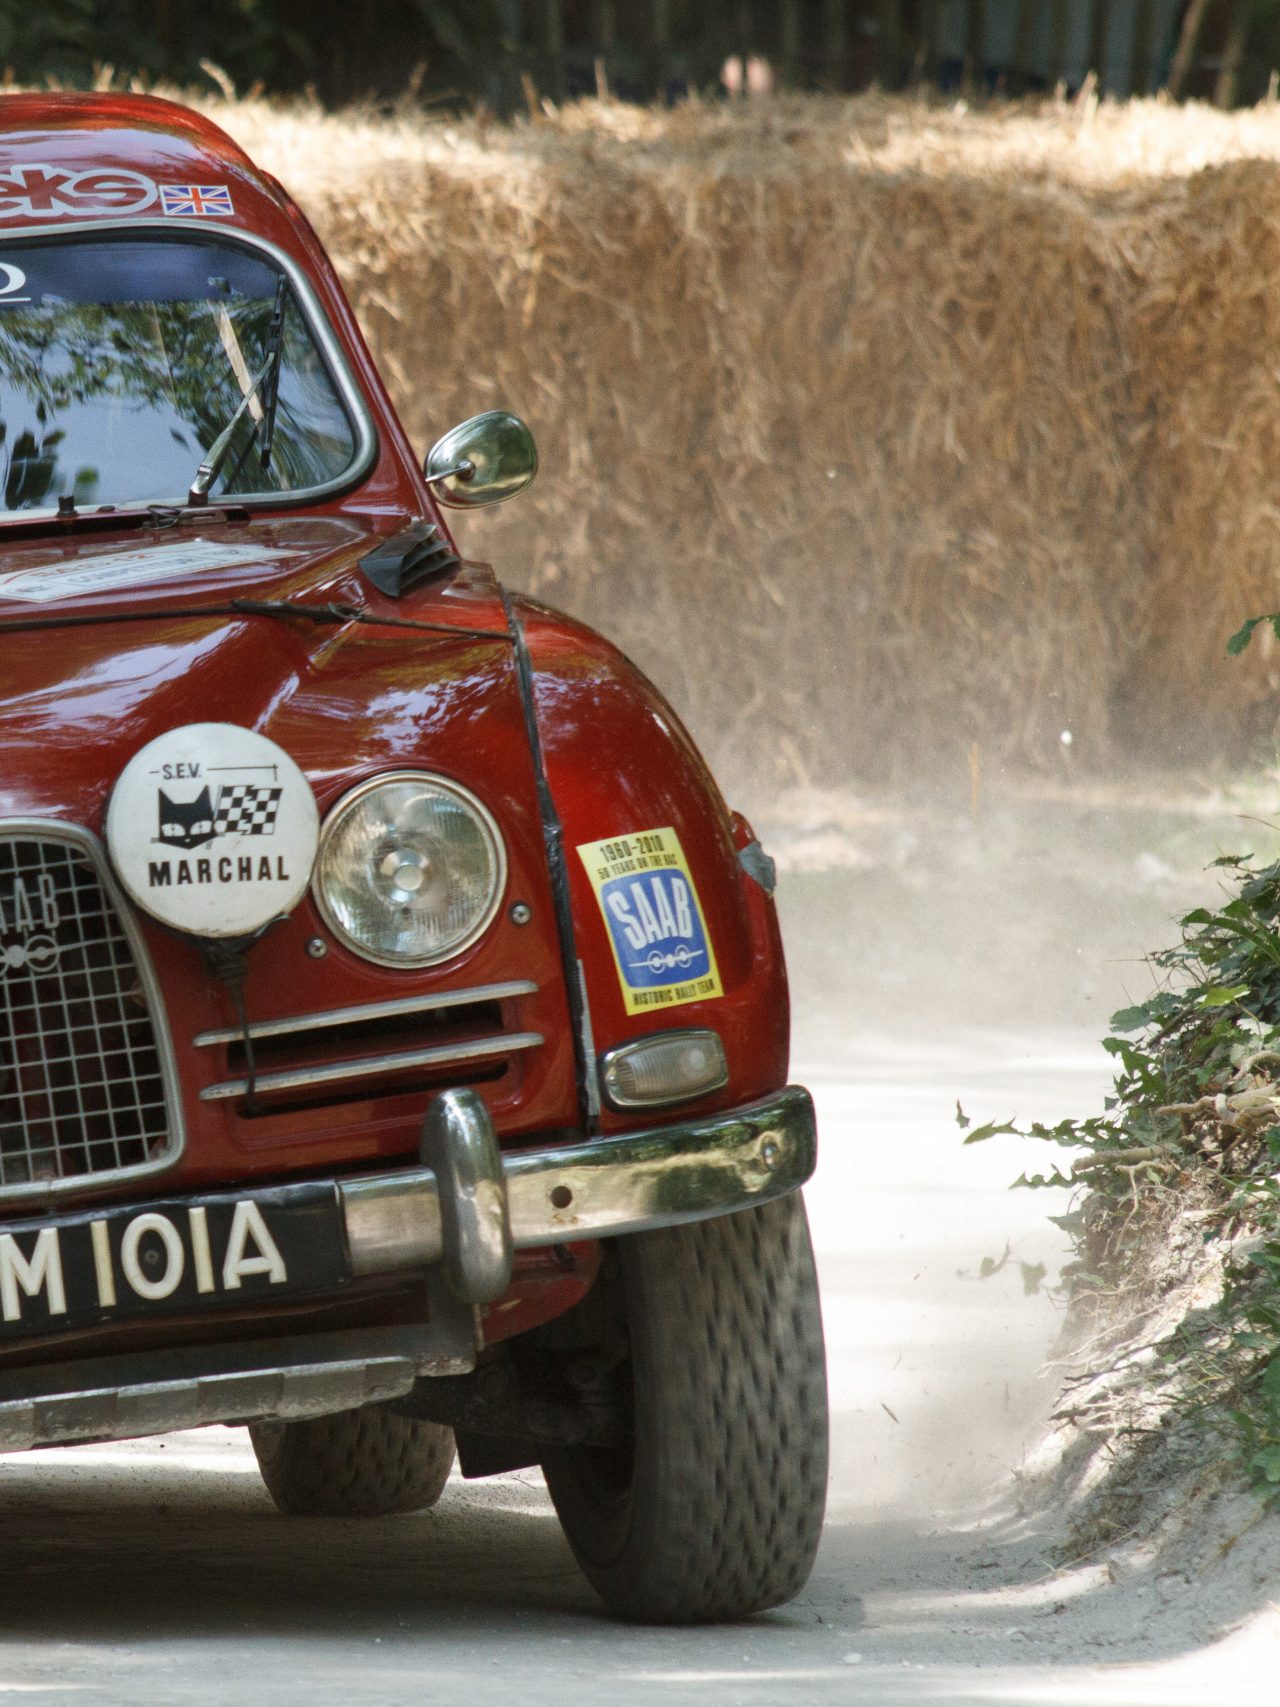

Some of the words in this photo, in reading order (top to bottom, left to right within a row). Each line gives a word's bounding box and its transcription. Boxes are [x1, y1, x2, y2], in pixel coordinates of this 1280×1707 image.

[599, 835, 665, 862] 1960-2010
[148, 856, 289, 887] MARCHAL
[606, 876, 694, 950] SAAB
[632, 989, 673, 1006] HISTORIC
